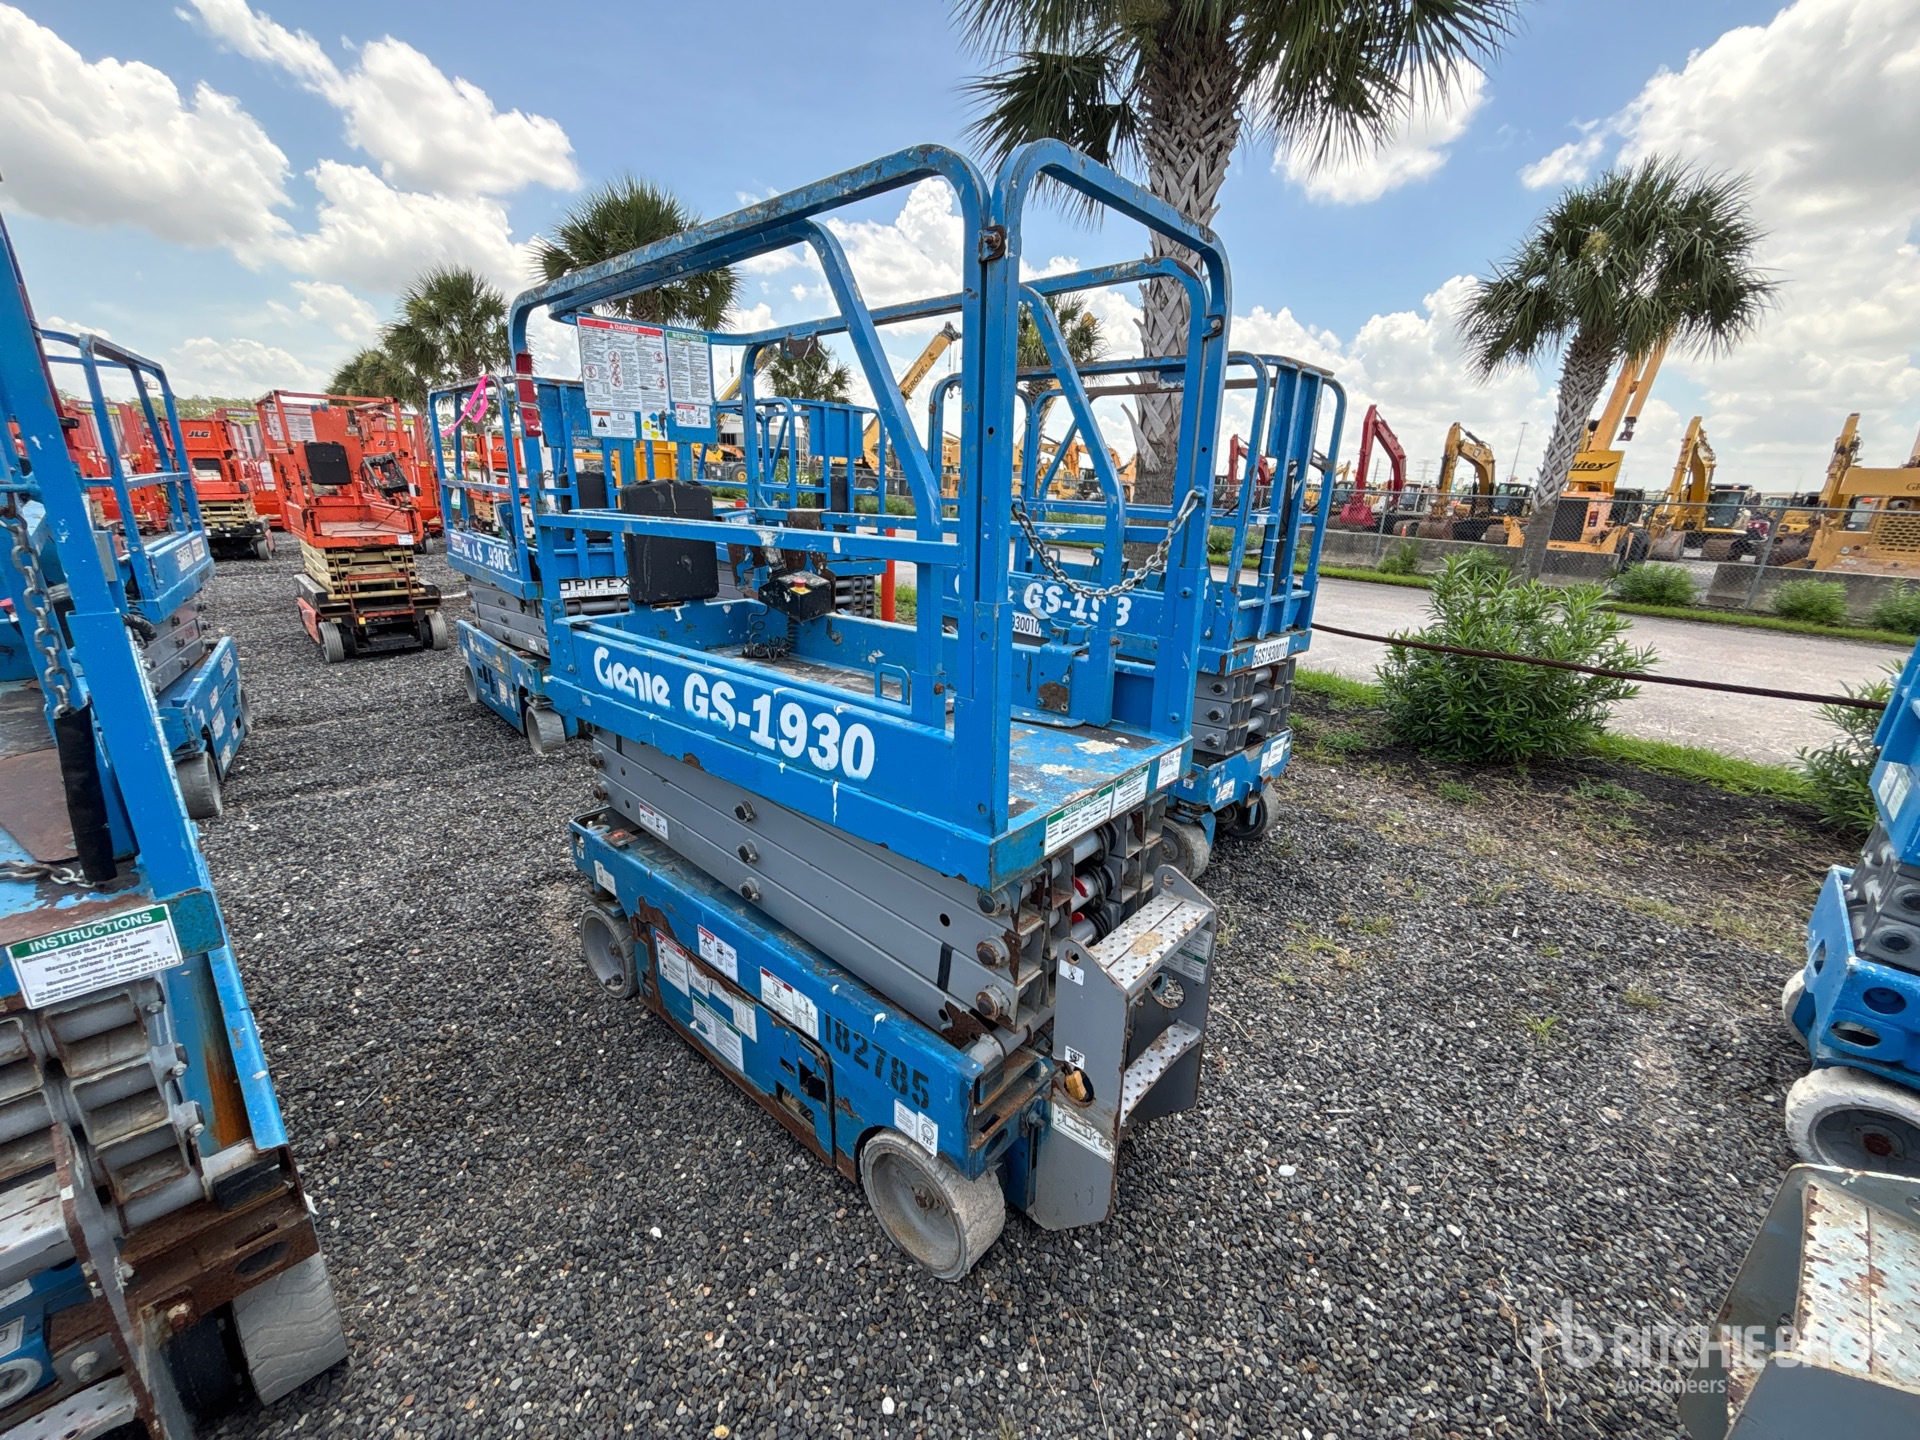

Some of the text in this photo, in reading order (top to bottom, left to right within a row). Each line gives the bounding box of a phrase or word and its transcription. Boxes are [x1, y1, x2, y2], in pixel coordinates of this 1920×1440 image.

[187, 430, 211, 439] JLG
[559, 577, 630, 592] OPIFEX
[594, 646, 876, 782] Genie GS-1930
[29, 912, 153, 953] INSTRUCTIONS
[66, 950, 82, 958] 105
[58, 966, 76, 975] 12.5
[825, 1010, 930, 1110] 182785
